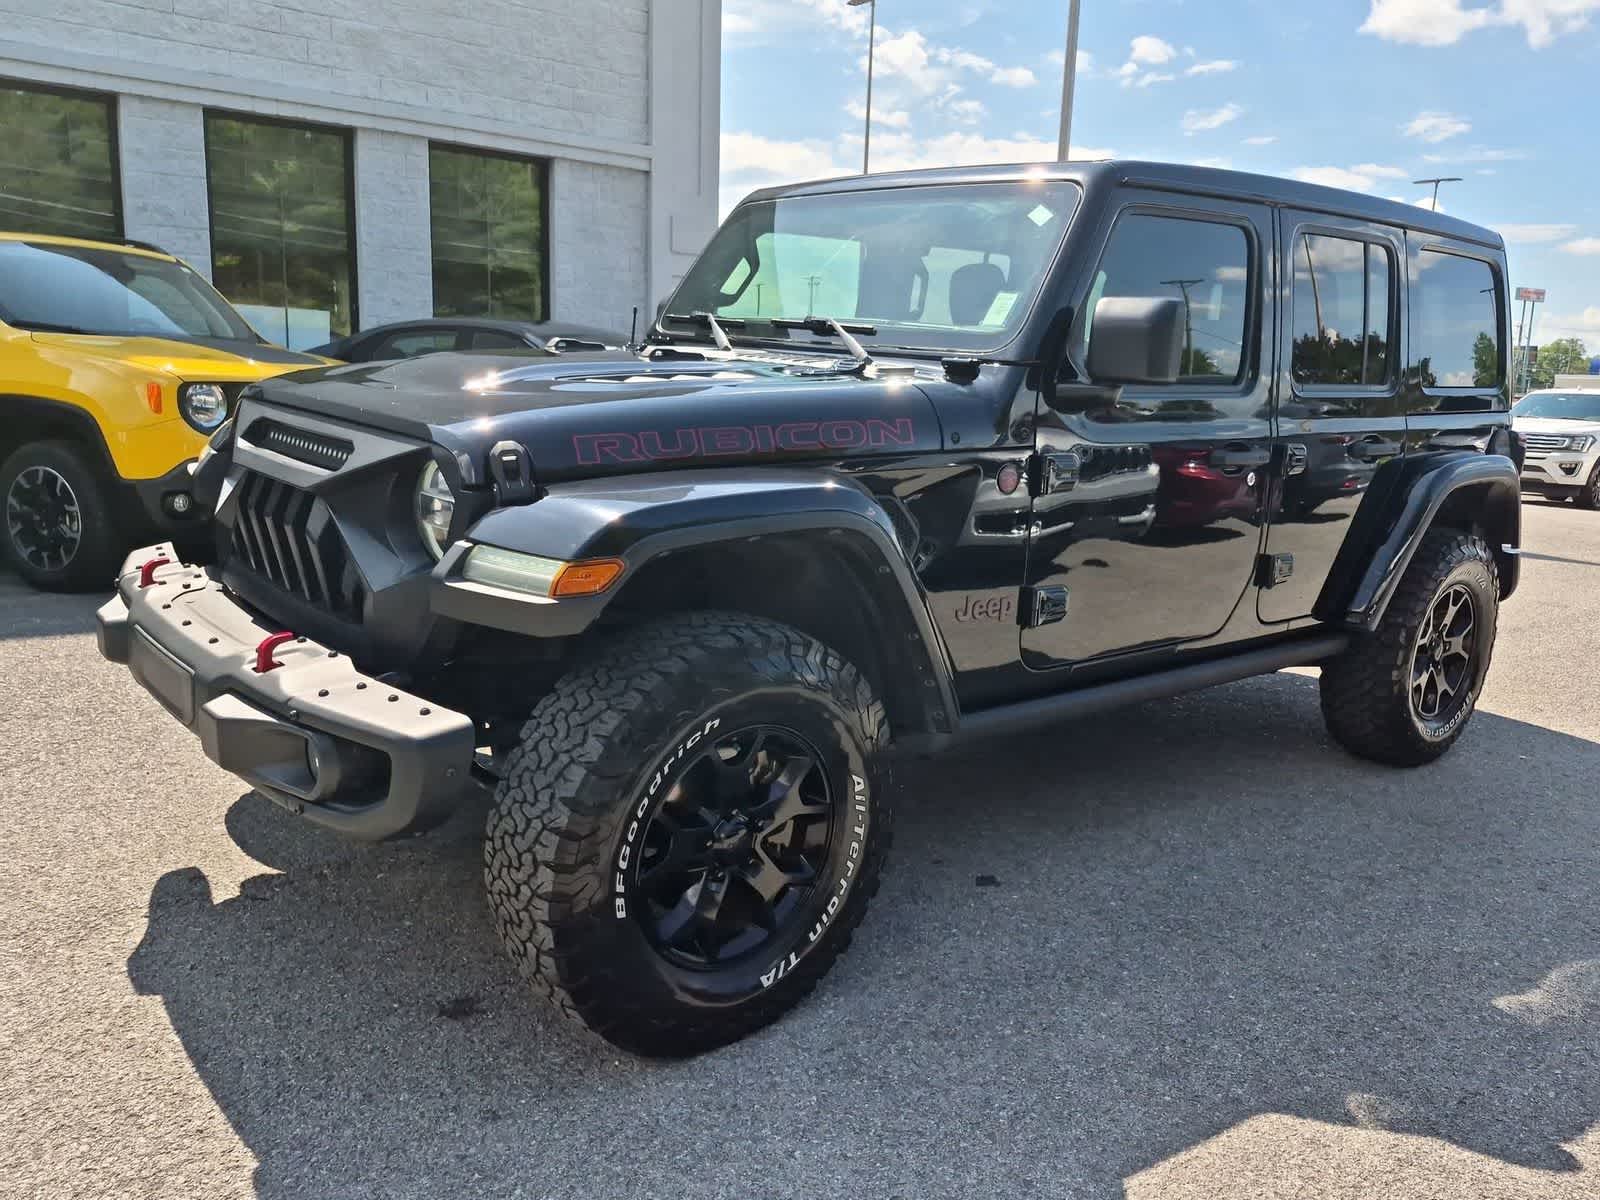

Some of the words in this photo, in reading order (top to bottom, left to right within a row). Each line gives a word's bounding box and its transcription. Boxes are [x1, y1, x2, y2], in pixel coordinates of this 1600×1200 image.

[573, 418, 915, 465] RUBICON
[954, 595, 1012, 623] Jeep
[615, 717, 721, 919] BFGoodrich
[808, 774, 866, 943] All-Terrain
[759, 951, 801, 988] T/A
